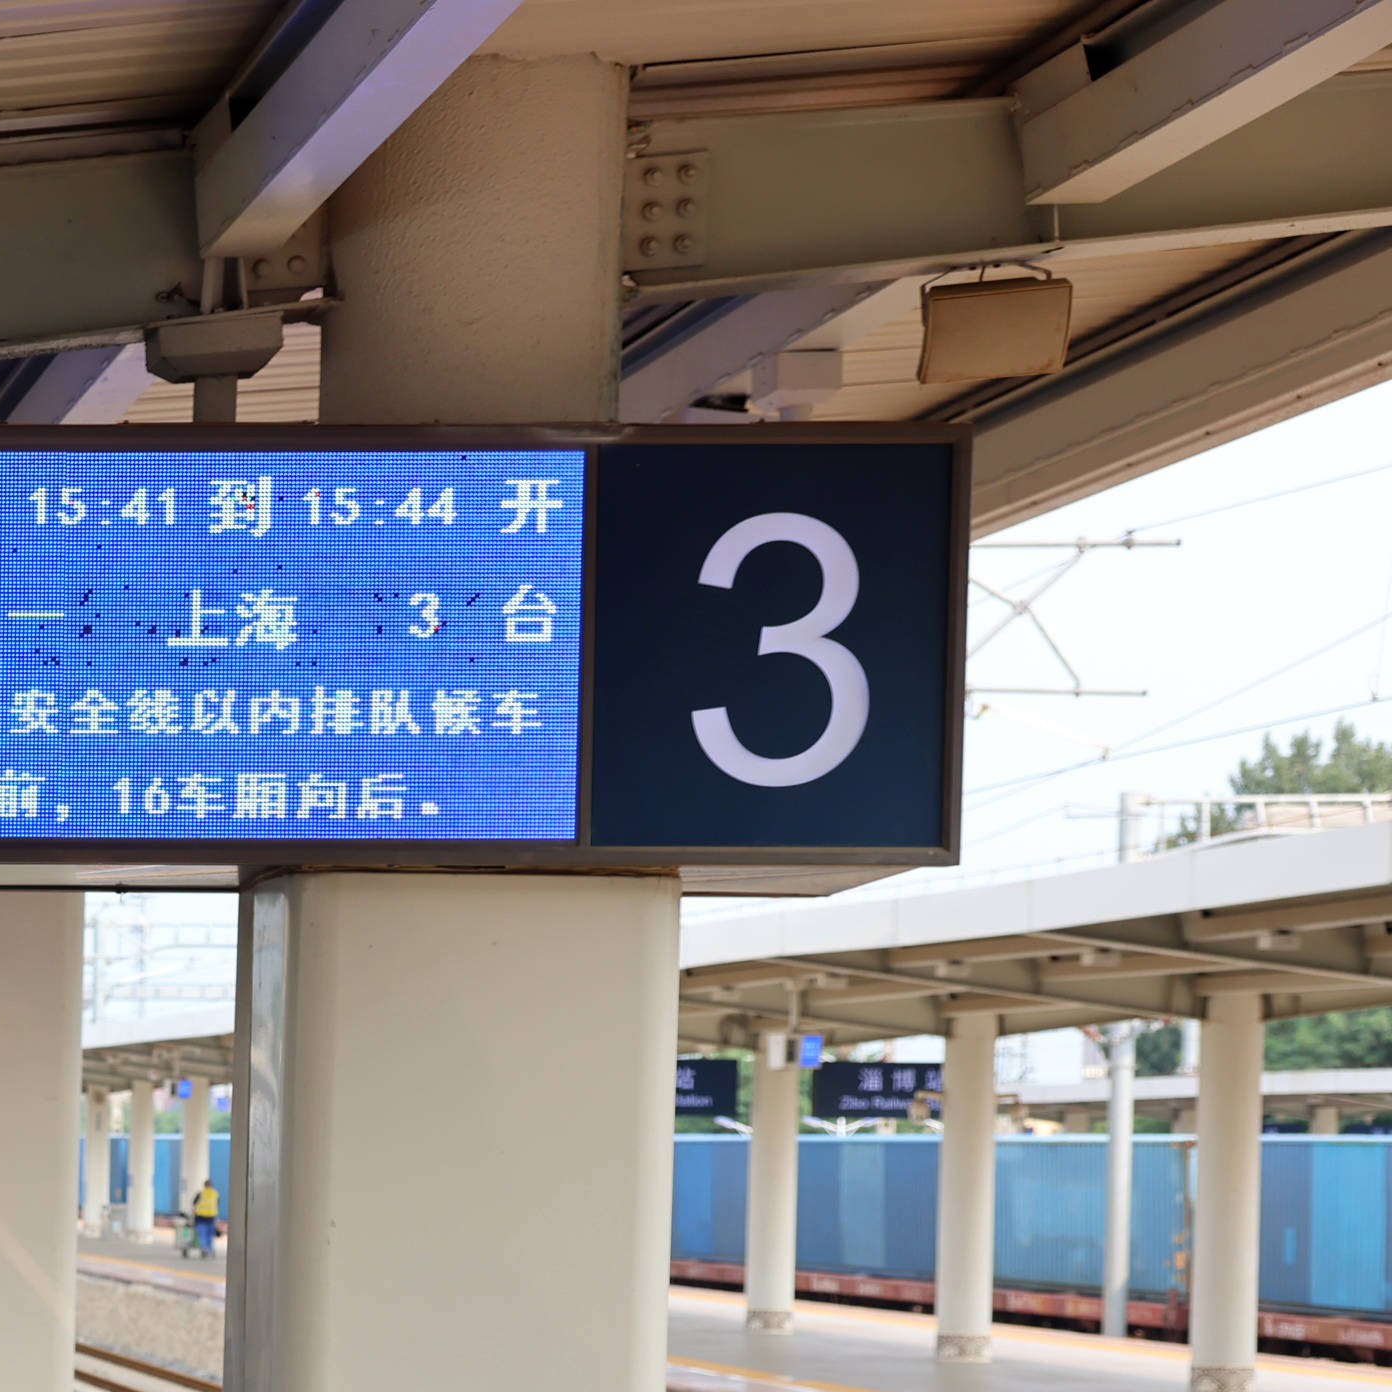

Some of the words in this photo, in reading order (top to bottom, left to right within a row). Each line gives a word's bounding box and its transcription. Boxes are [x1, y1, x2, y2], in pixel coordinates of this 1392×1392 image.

[28, 487, 176, 527] 15:41
[207, 475, 274, 537] 到
[301, 487, 458, 526] 15:44
[499, 478, 563, 534] 开
[166, 586, 299, 650] 上海
[407, 592, 441, 639] 3
[500, 583, 558, 645] 台
[689, 511, 871, 788] 3
